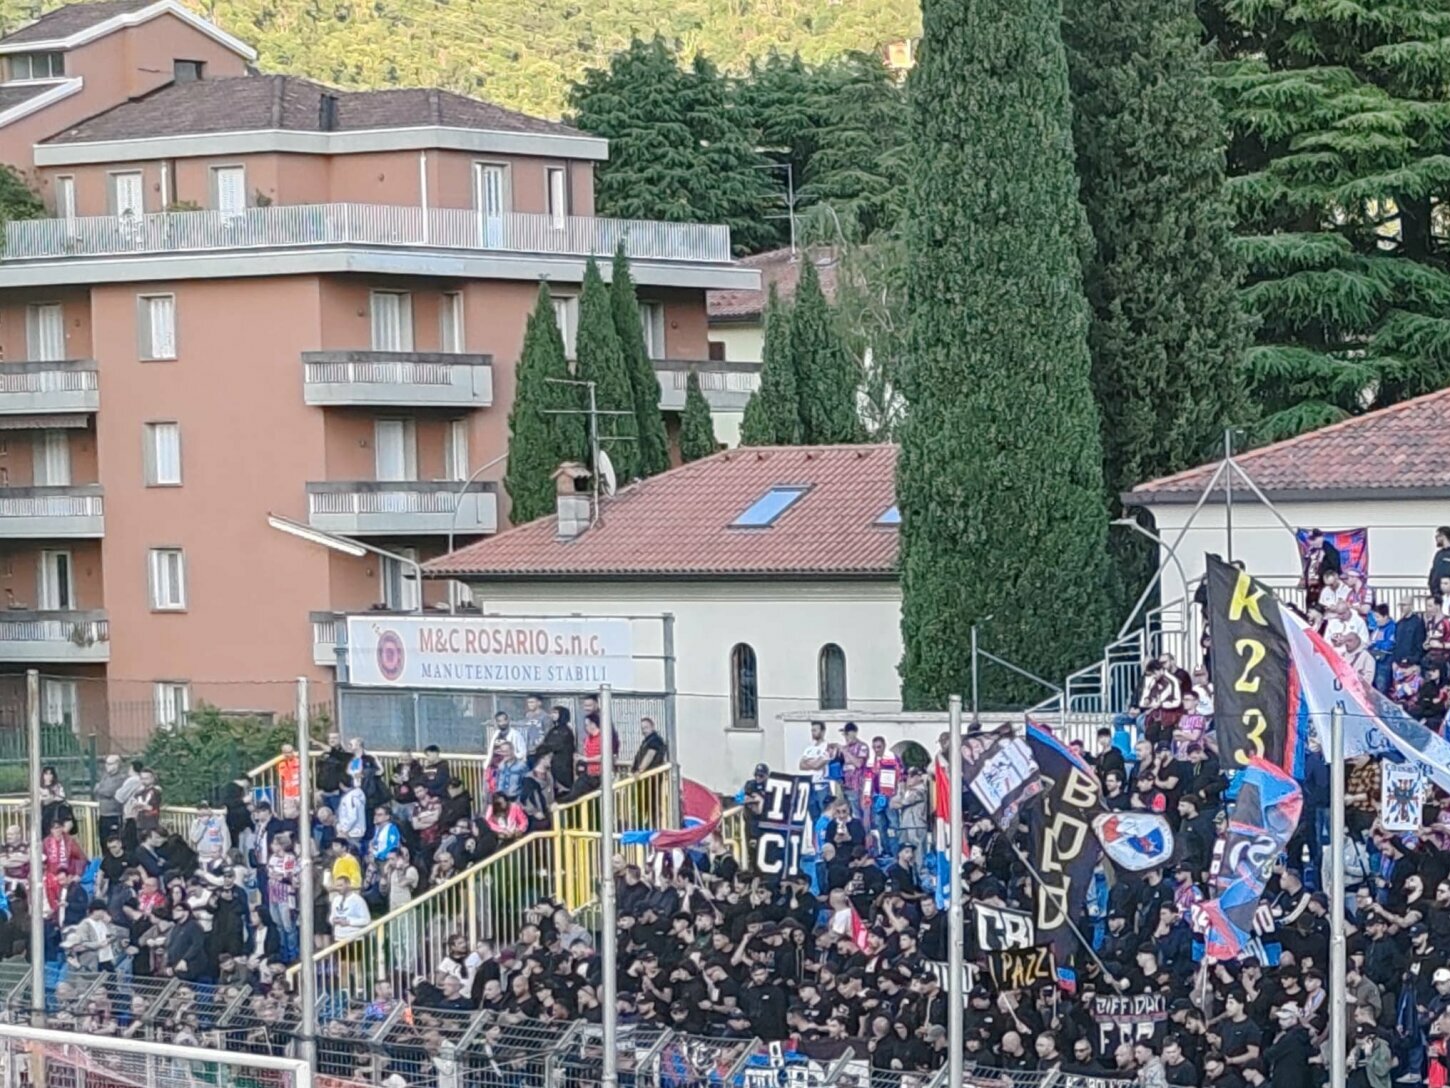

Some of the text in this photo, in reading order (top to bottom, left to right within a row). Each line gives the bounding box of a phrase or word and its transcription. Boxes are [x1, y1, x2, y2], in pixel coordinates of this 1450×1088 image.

[419, 627, 606, 656] M&C ROSARIO s.n.c.
[420, 662, 606, 681] MANUTENZIONE STABILI
